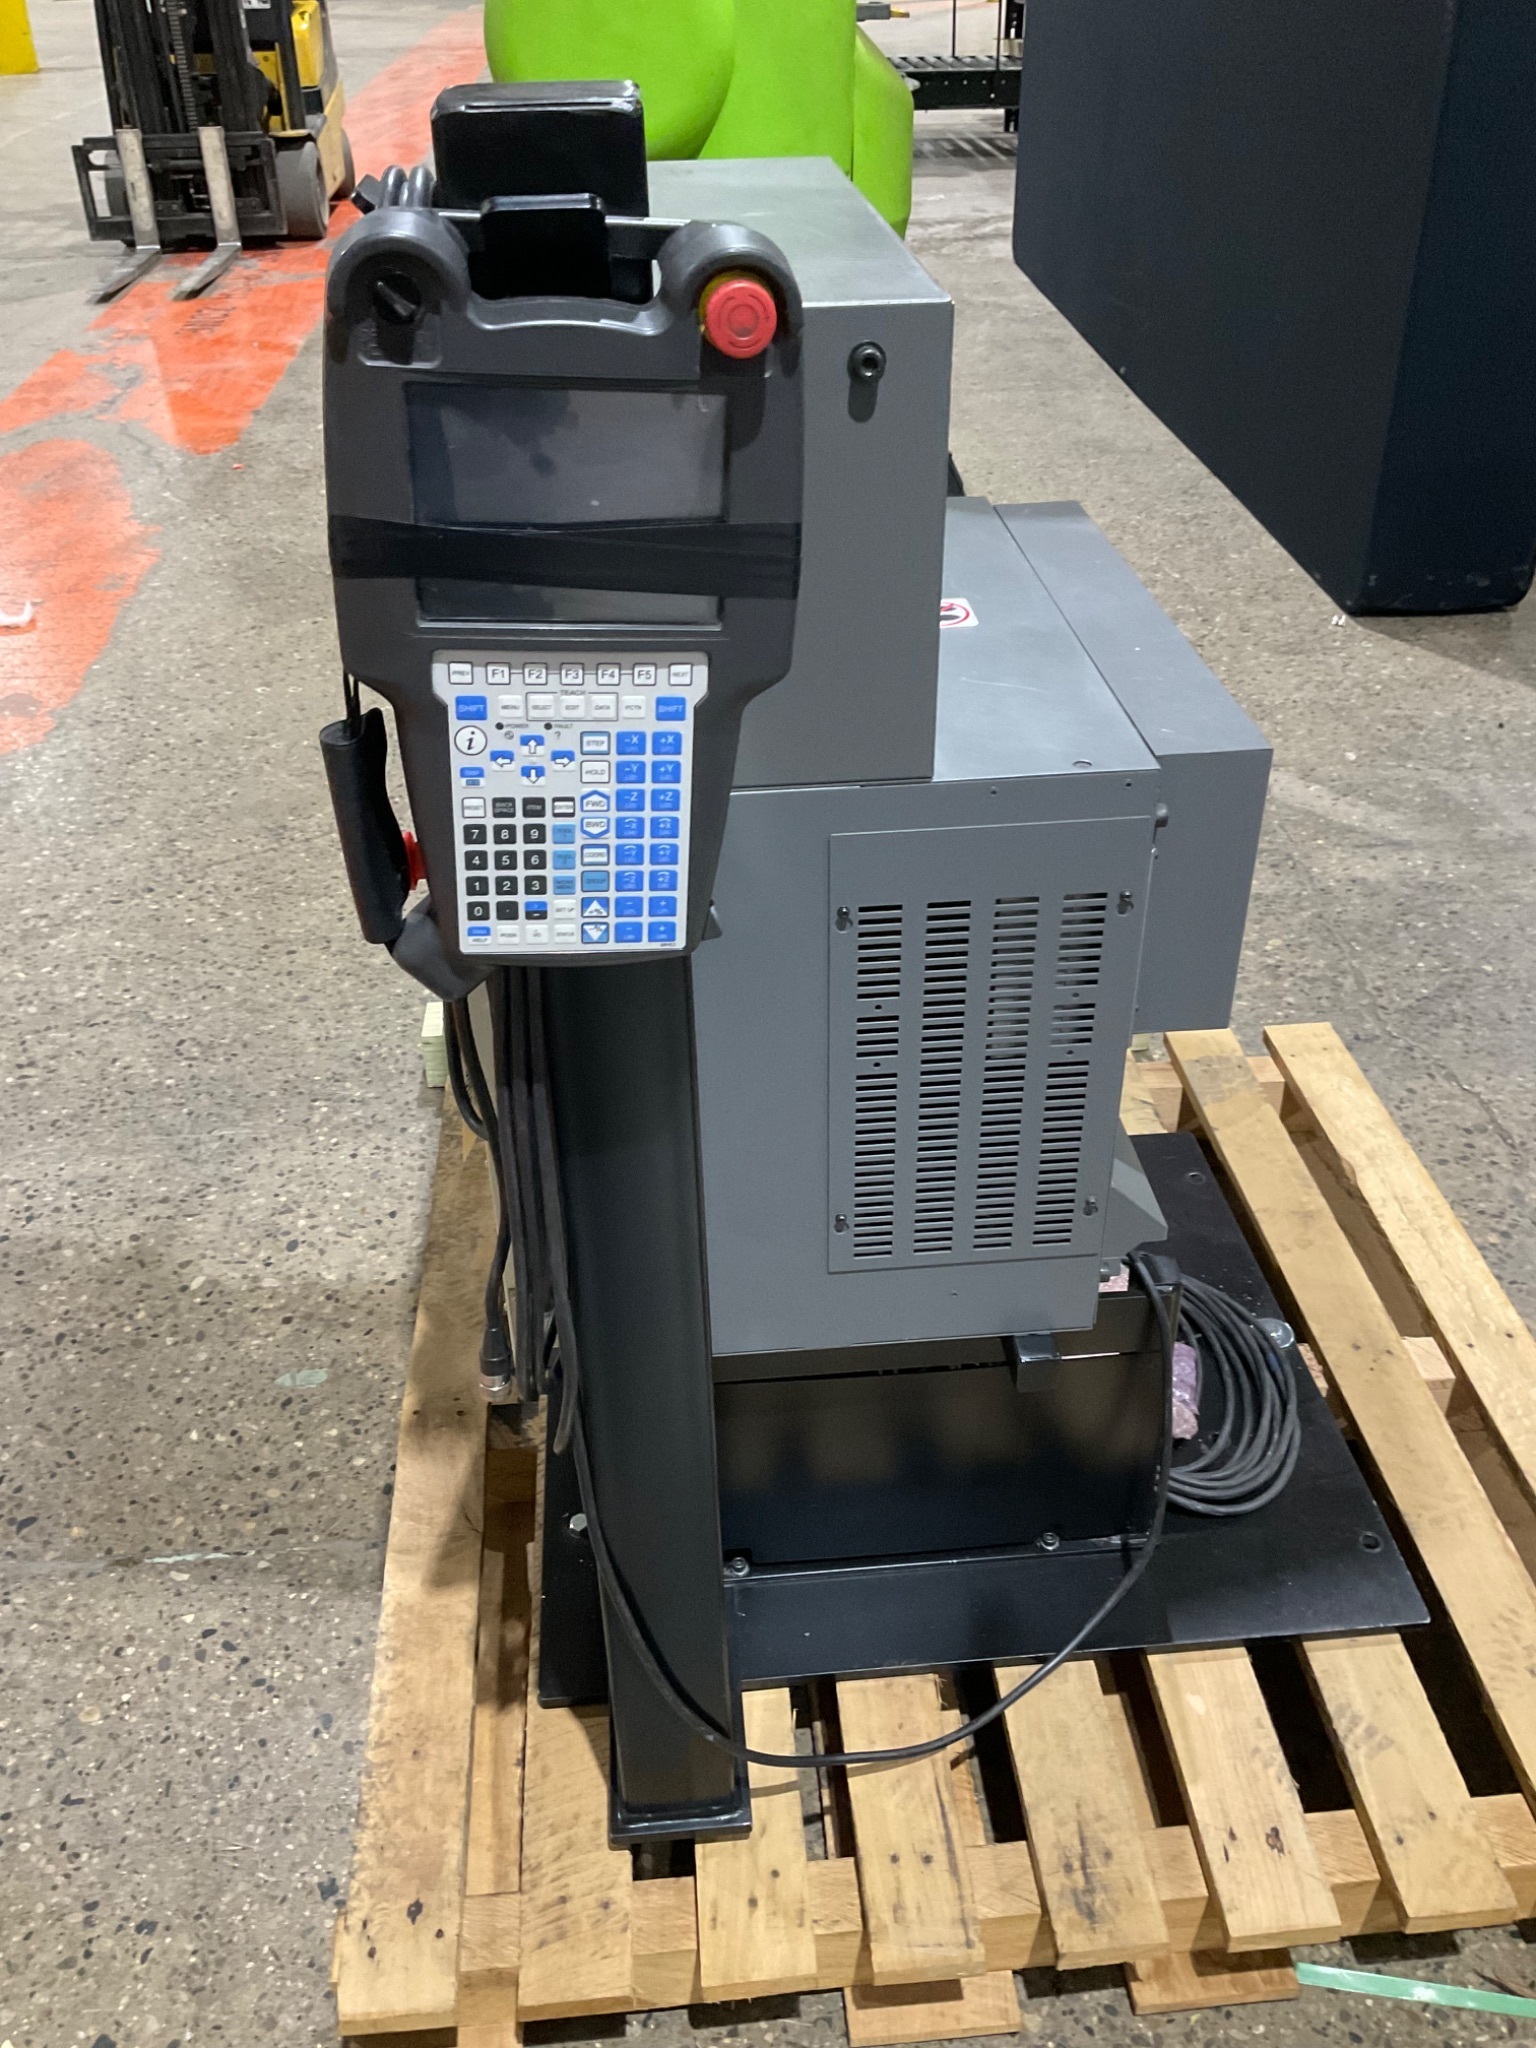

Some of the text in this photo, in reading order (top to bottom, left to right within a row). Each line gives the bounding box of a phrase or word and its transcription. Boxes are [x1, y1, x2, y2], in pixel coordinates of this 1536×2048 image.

[492, 669, 505, 678] F1
[528, 669, 543, 679] F2
[565, 669, 579, 679] F3
[601, 669, 615, 679] F4
[637, 670, 652, 680] F5
[458, 704, 485, 713] SHIFT
[658, 704, 684, 713] SHIFT
[585, 739, 605, 747] STEP
[585, 768, 606, 776] HOLD
[585, 800, 606, 808] FWD
[585, 820, 606, 828] BWD
[470, 829, 479, 840] 7
[500, 829, 509, 840] 8
[530, 829, 539, 840] 9
[472, 855, 480, 866] 4
[501, 855, 510, 866] 5
[531, 854, 540, 866] 6
[473, 881, 480, 891] 1
[502, 880, 511, 891] 2
[531, 880, 540, 891] 3
[473, 906, 483, 916] 0
